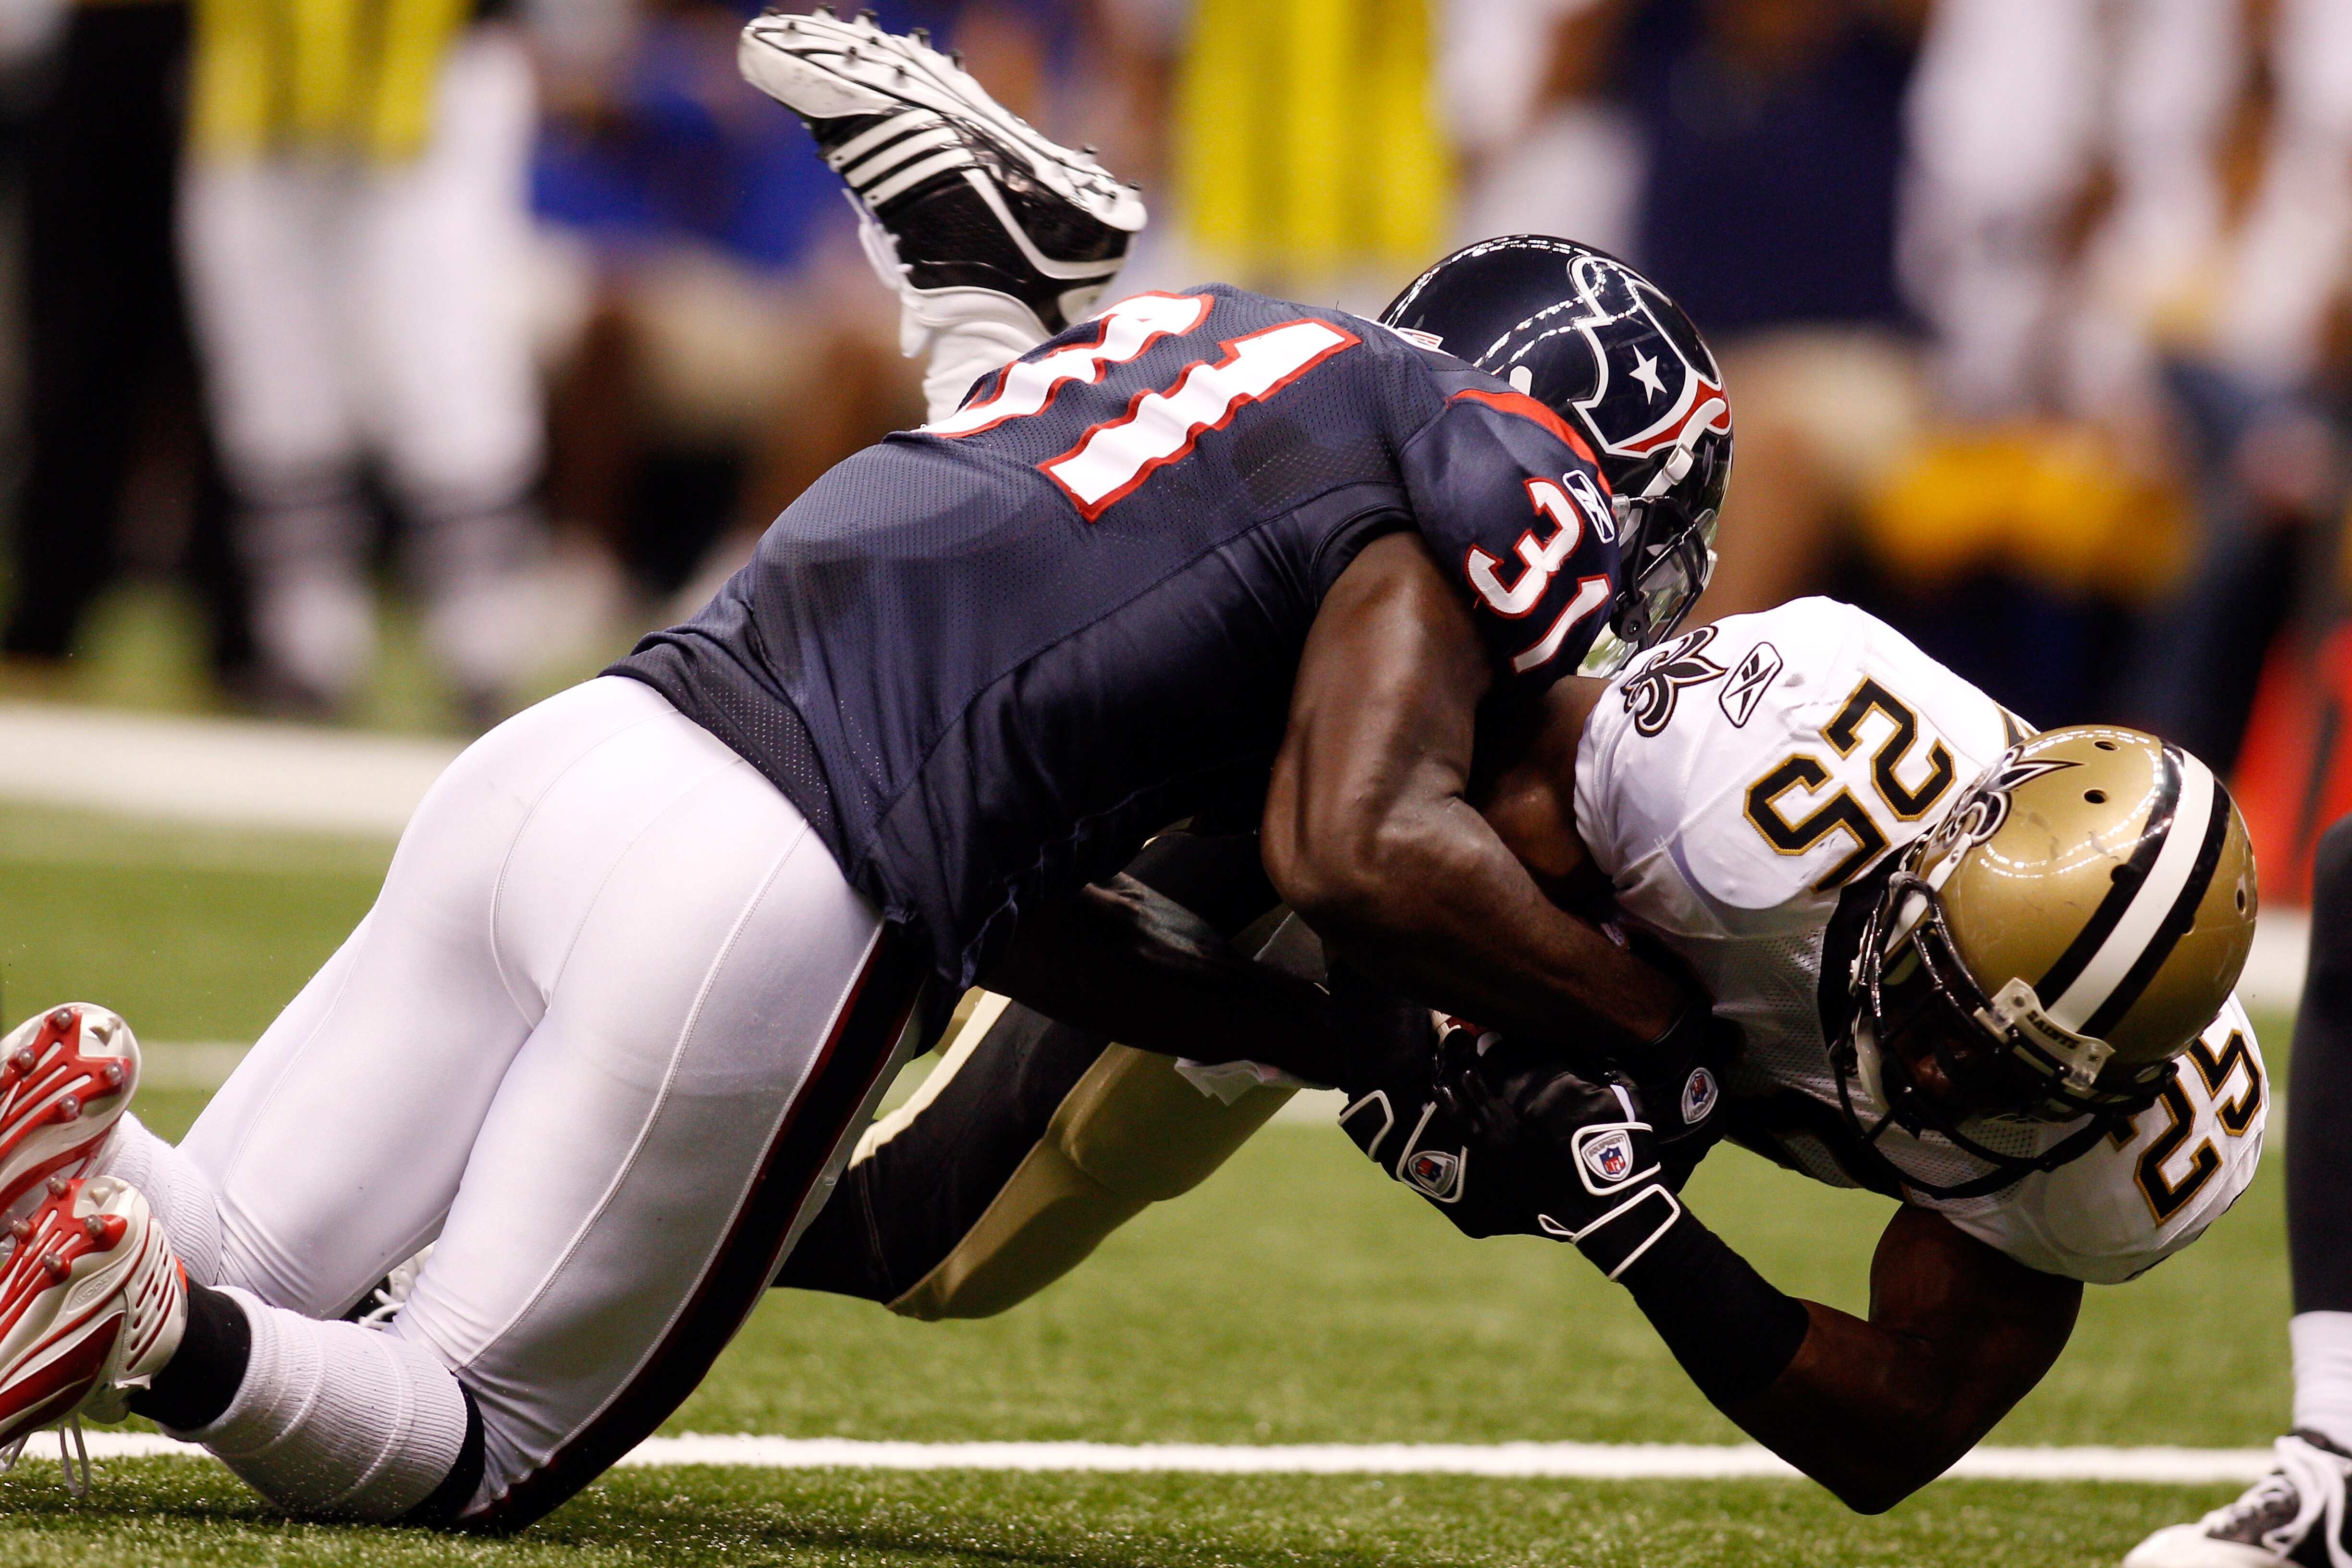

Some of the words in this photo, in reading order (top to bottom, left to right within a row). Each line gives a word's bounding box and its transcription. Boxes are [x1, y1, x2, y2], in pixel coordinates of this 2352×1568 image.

[908, 290, 1361, 522] 31
[1464, 476, 1612, 676] 31
[1742, 673, 1957, 895] 25
[2026, 1010, 2080, 1049] SAINTS
[2107, 1028, 2263, 1228] 25
[1605, 1154, 1625, 1173] NFL
